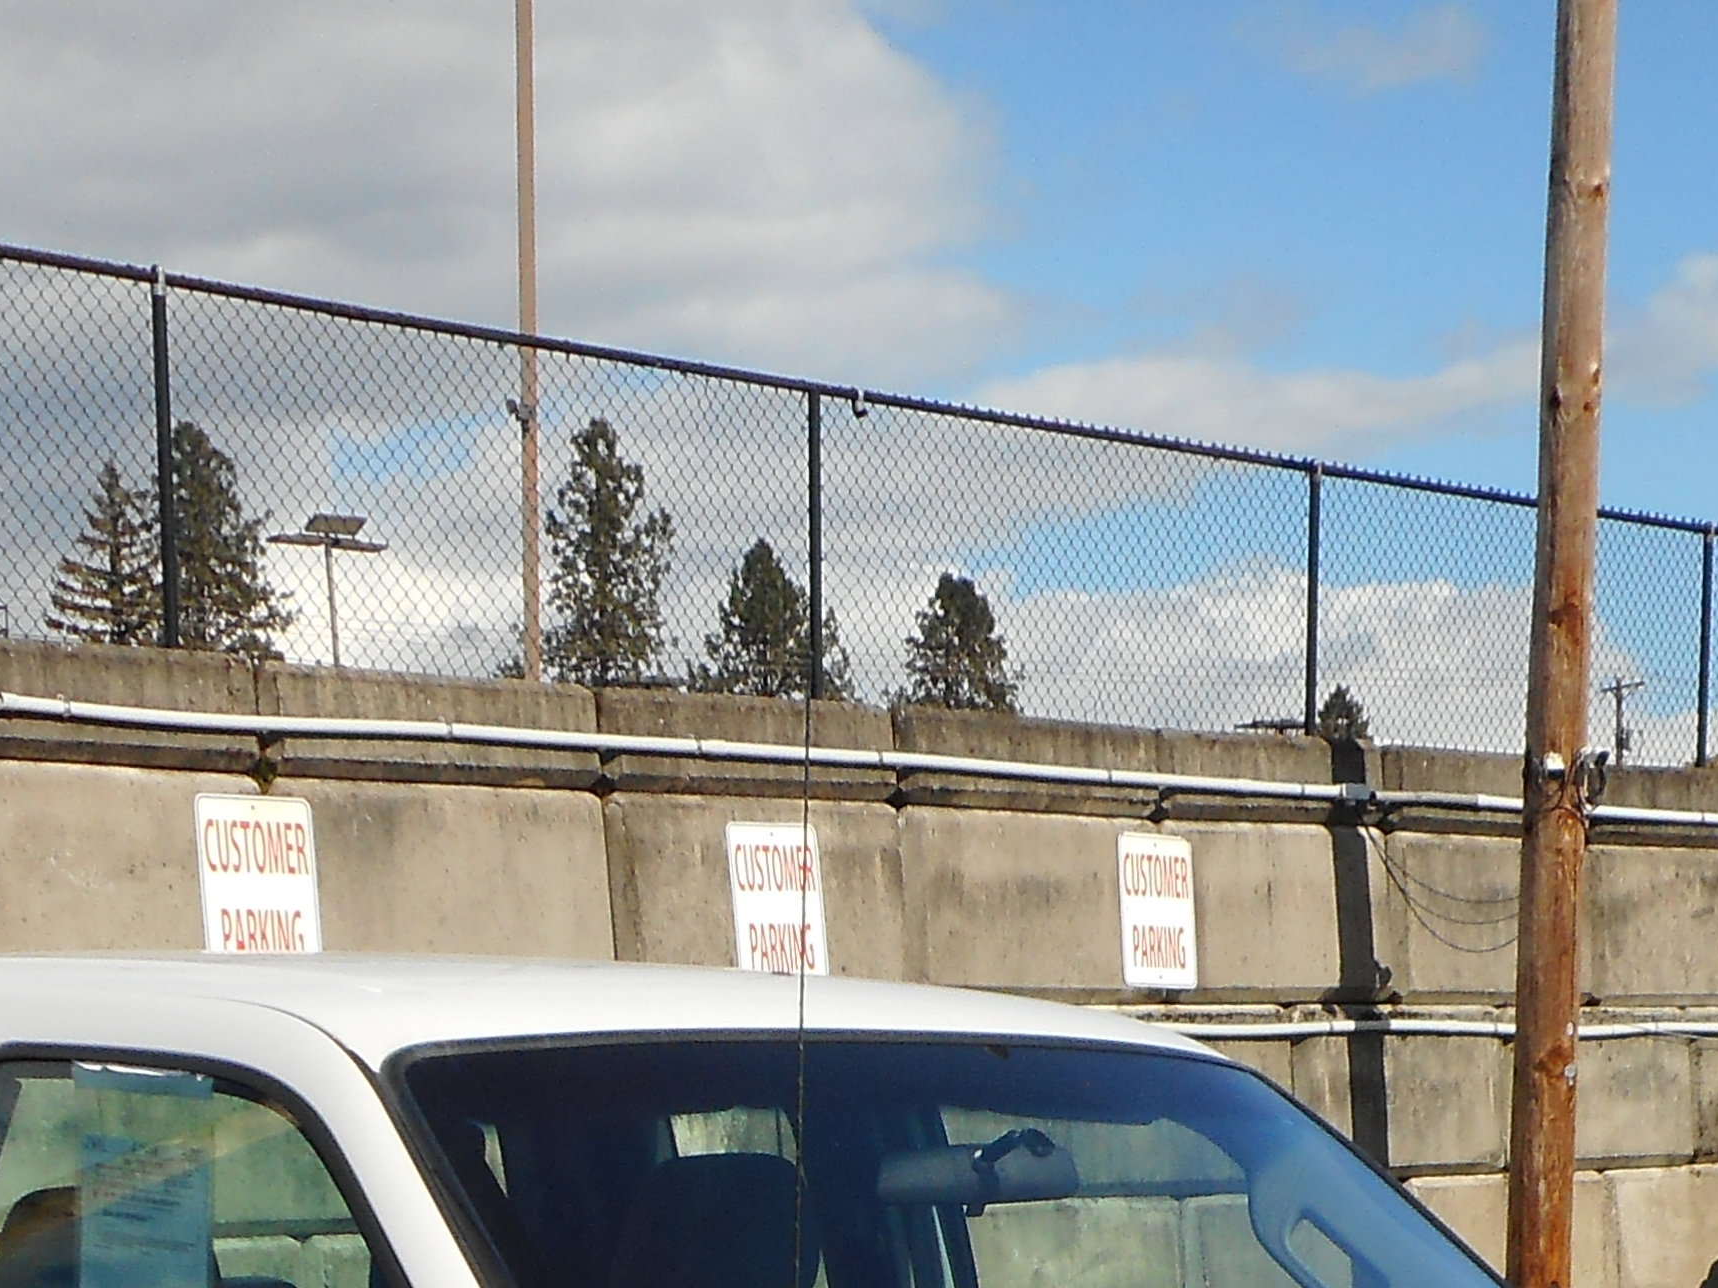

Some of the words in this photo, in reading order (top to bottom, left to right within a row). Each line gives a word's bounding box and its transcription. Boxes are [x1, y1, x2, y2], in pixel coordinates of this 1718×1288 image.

[204, 818, 310, 876] CUSTOMER
[735, 843, 817, 892] CUSTOMER
[1123, 852, 1190, 900] CUSTOMER
[221, 907, 306, 952] PARKING
[749, 922, 815, 972] PARKING
[1132, 924, 1187, 970] PARKING
